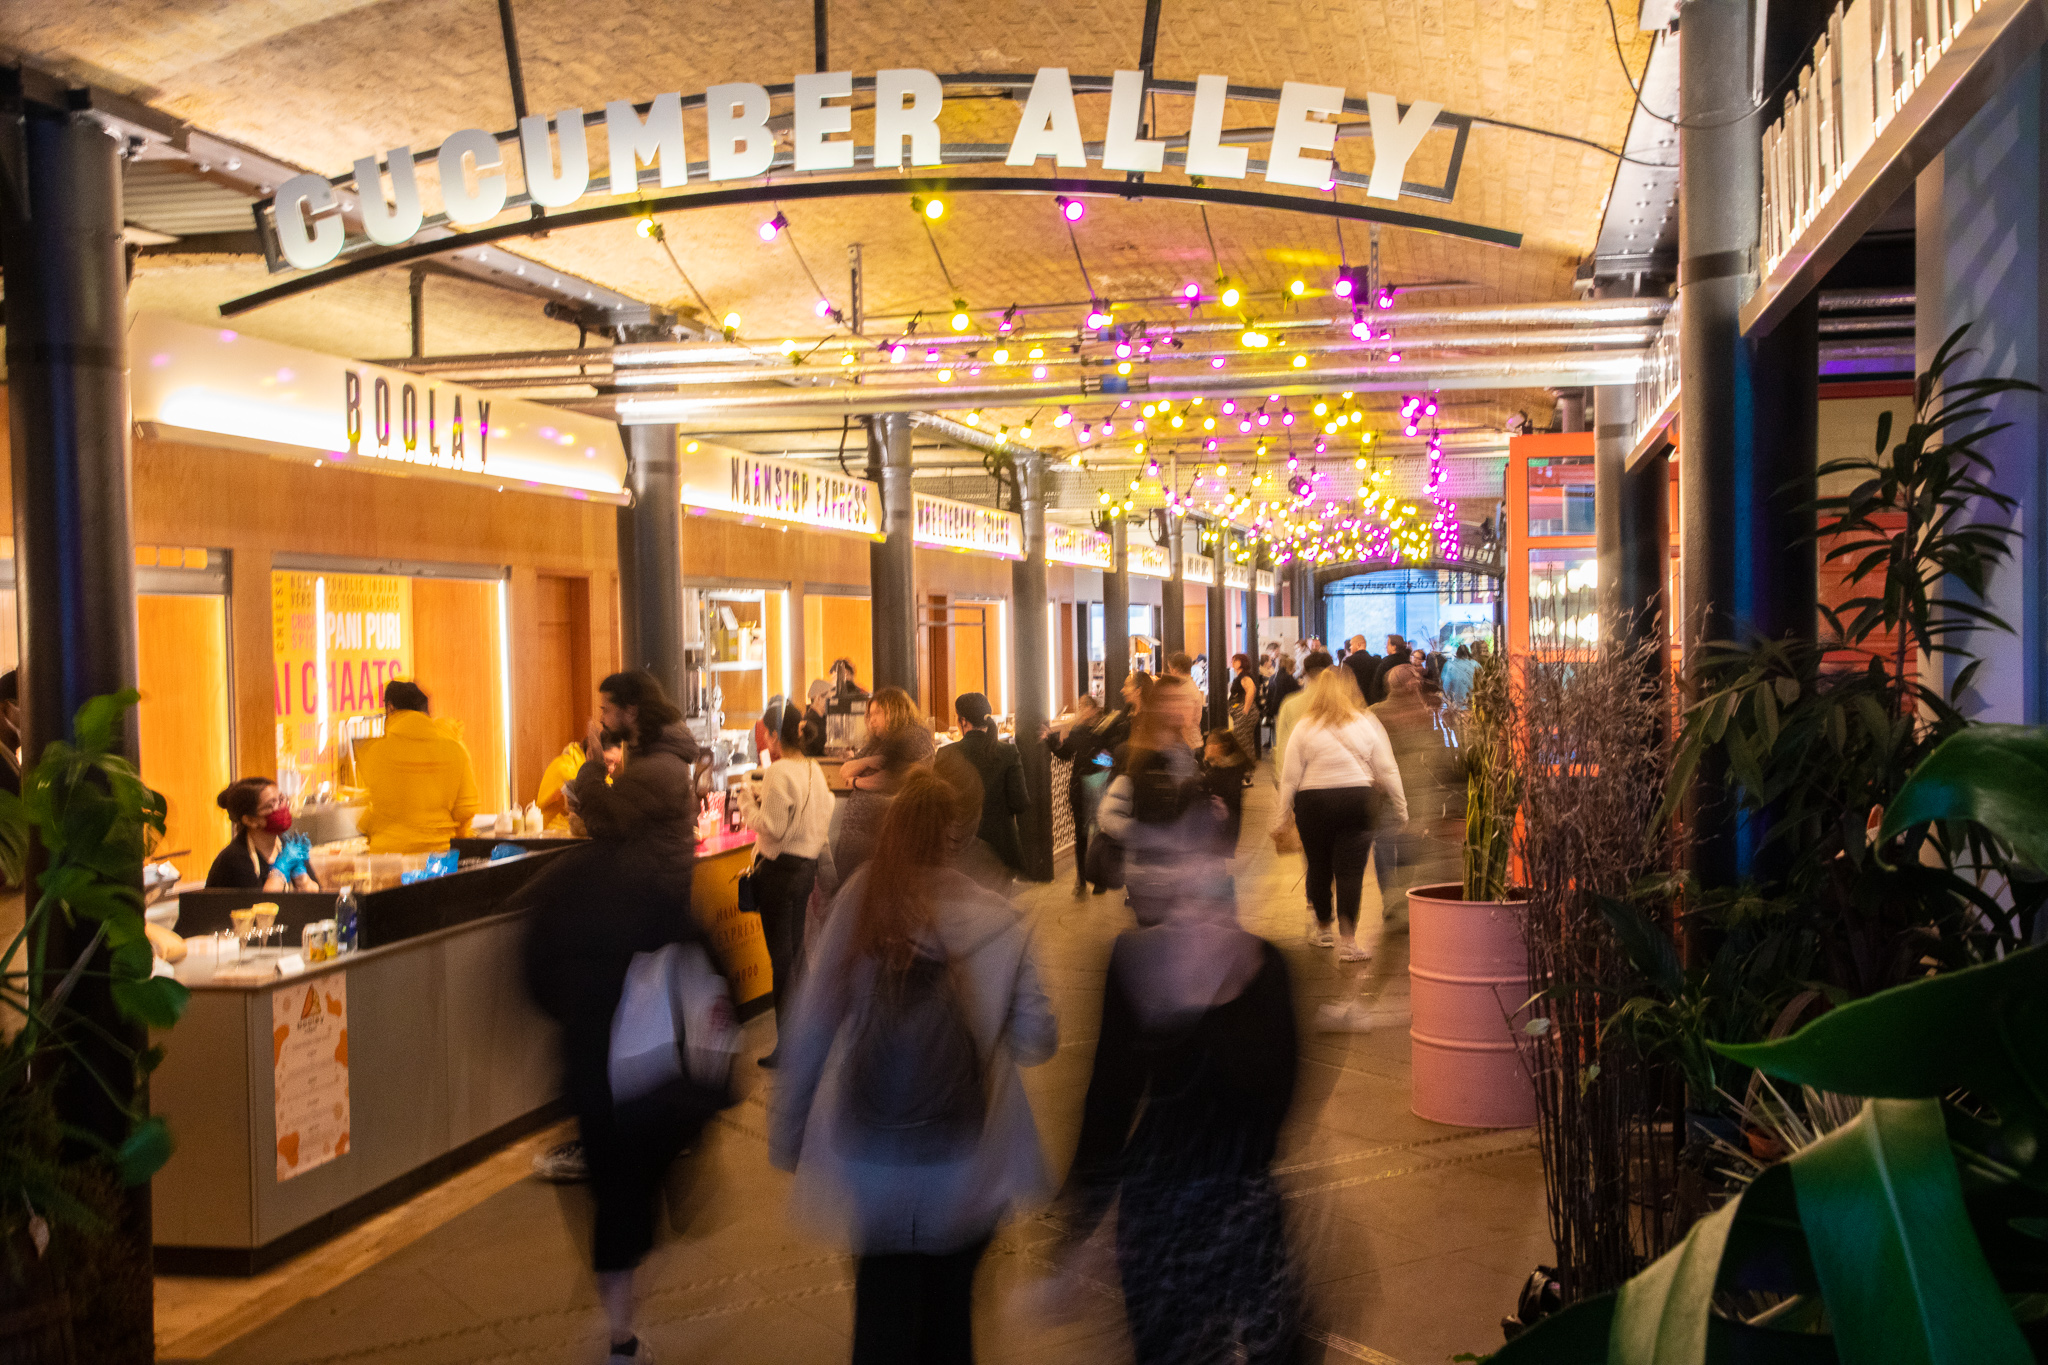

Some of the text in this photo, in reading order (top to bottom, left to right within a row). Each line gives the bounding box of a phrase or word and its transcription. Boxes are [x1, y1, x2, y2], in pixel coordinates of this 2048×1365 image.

[274, 67, 1444, 270] CUCUMBER ALLEY
[345, 369, 492, 465] BOOLAY
[731, 455, 868, 525] NAANSTOP EXPRESS
[290, 612, 317, 631] CRISP
[375, 593, 401, 610] SHOTS
[290, 632, 317, 651] SPIC
[325, 610, 402, 651] PANI PURI
